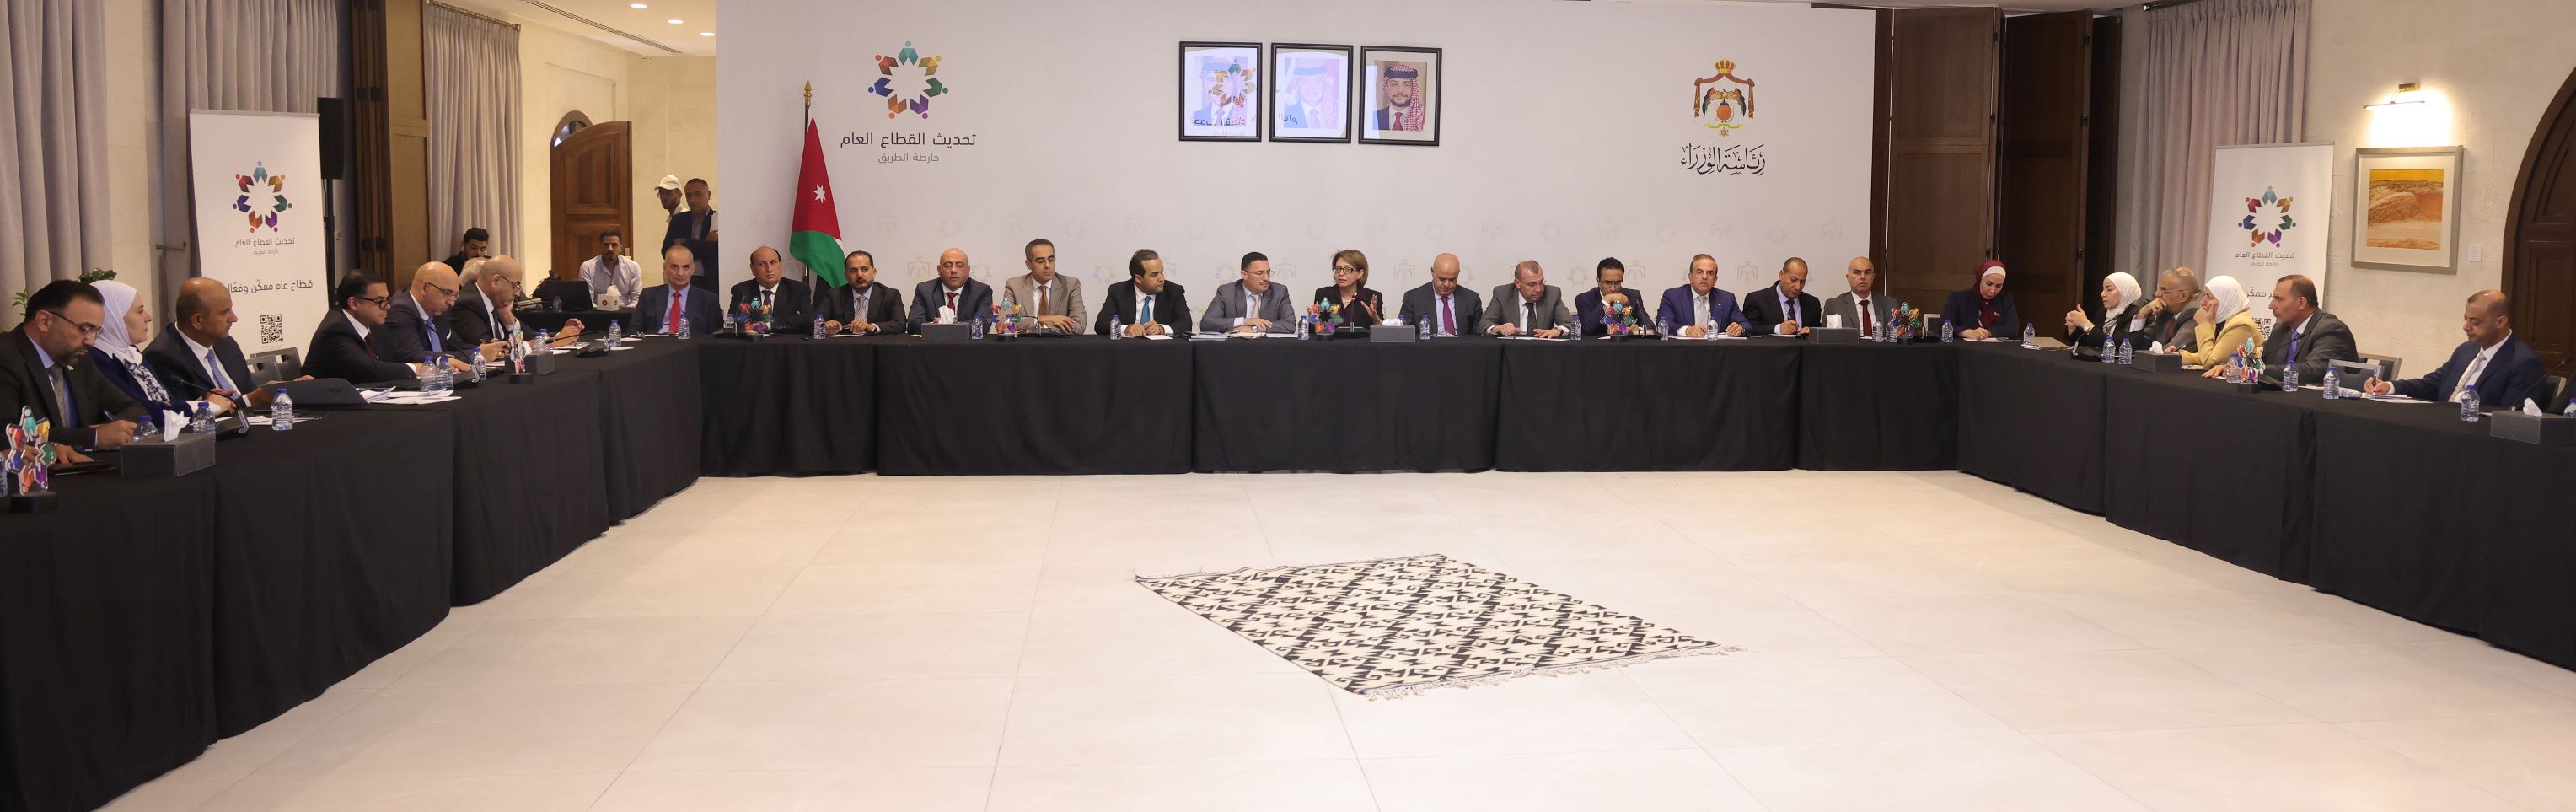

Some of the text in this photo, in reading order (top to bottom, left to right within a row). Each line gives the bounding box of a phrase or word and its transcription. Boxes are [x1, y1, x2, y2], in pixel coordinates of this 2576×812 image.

[840, 132, 977, 149] تحديث القطاع العام
[877, 152, 940, 164] خارطة الطريق
[235, 237, 295, 248] تحديث القطاع العام
[2234, 251, 2250, 260] العام
[2251, 251, 2273, 260] القطاع
[275, 280, 288, 293] عام
[291, 279, 314, 292] قطاع
